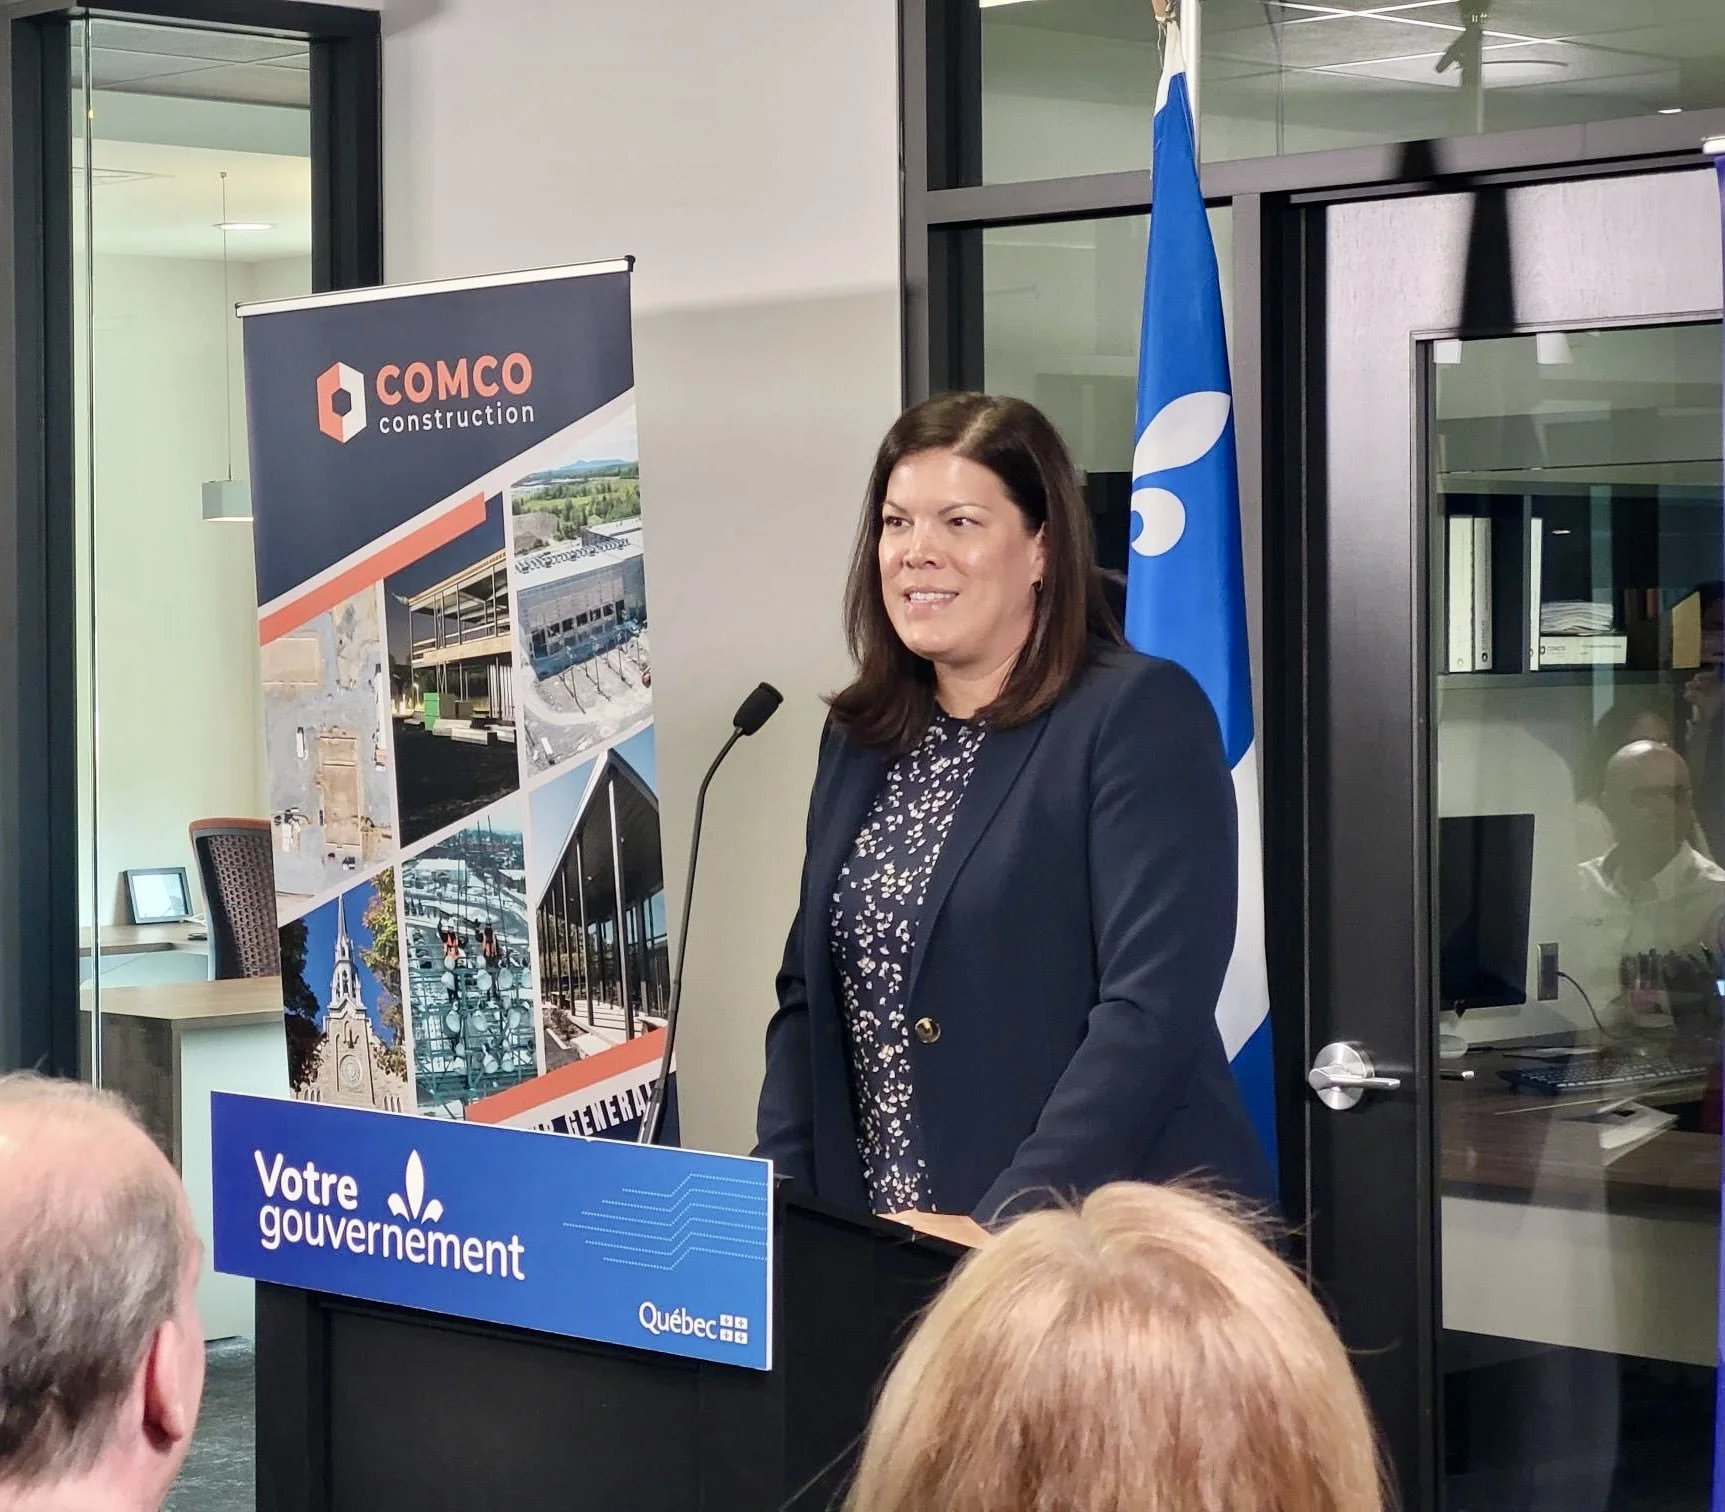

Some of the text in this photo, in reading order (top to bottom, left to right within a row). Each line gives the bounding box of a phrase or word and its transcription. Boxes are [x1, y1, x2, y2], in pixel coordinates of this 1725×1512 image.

[376, 352, 532, 406] COMCO
[379, 401, 534, 434] construction
[254, 1149, 358, 1207] Votre
[259, 1205, 525, 1281] gouvernement
[638, 1301, 717, 1340] Québec
